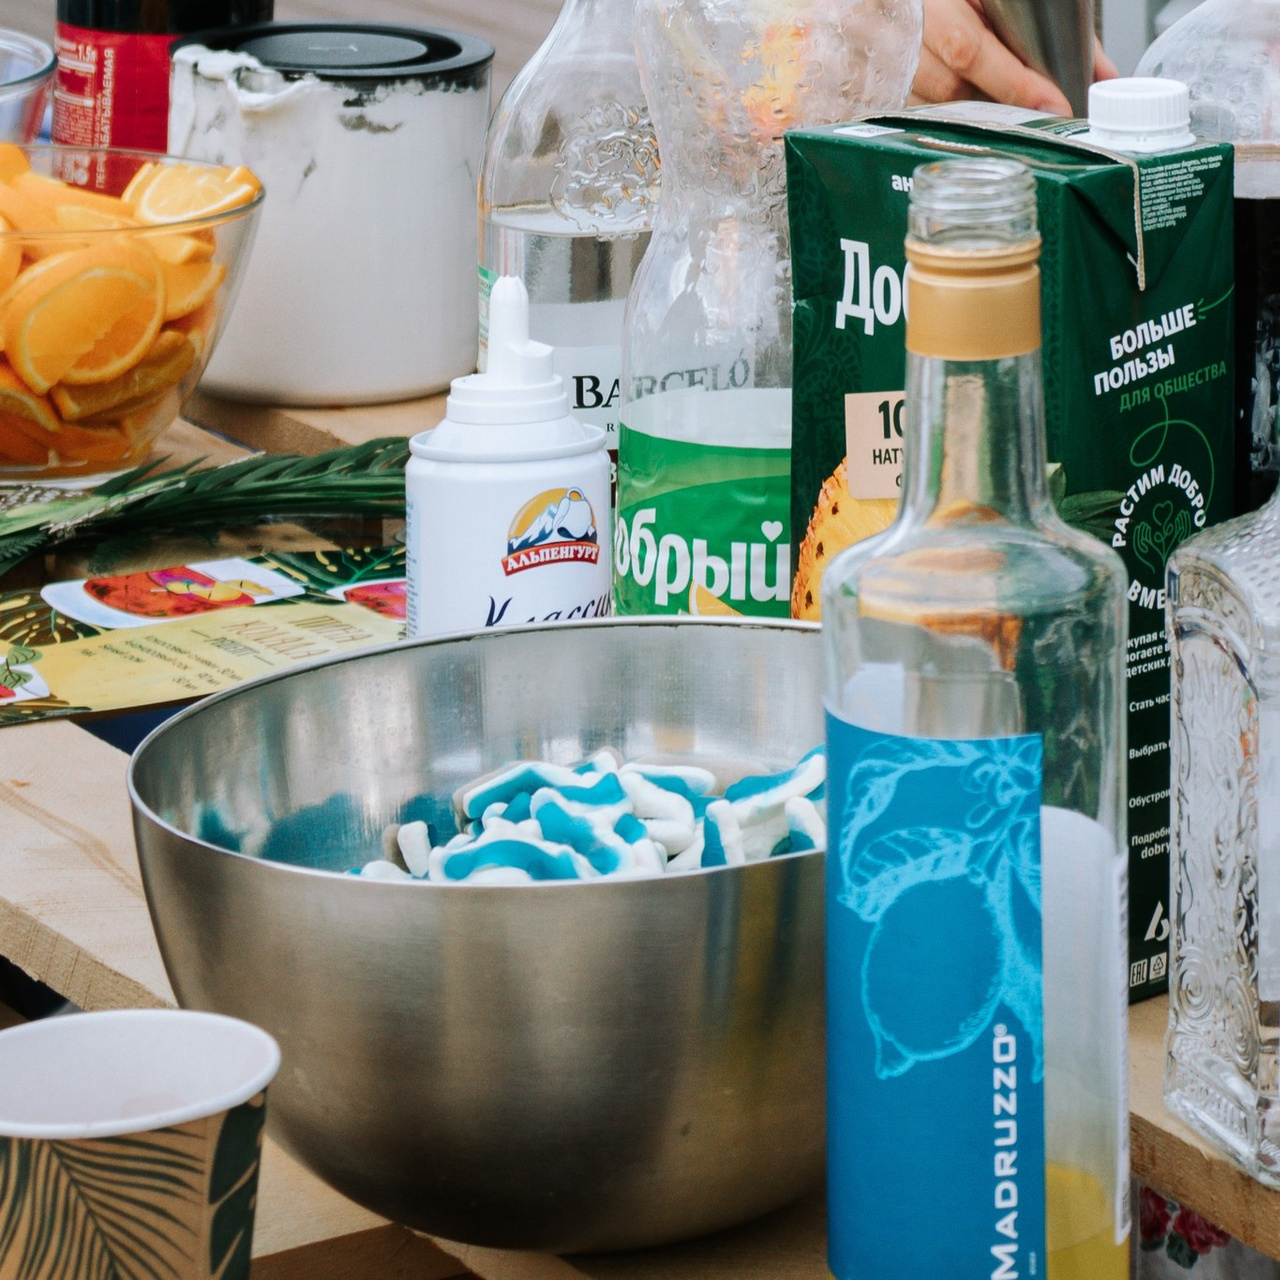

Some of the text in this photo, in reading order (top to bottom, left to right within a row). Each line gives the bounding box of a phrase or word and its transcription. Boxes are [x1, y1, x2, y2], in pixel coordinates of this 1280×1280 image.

[1110, 303, 1197, 361] БОЛЬШЕ
[1094, 344, 1175, 396] ПОЛЬЗЫ
[1120, 360, 1227, 413] ДЛЯ ОБЩЕСТВА
[1112, 463, 1206, 548] РАСТИМ ДОБРО
[507, 546, 598, 572] АЛЬПЕНГУРТ
[615, 507, 791, 606] обрый
[1127, 579, 1166, 610] ВМЕ
[1127, 632, 1158, 648] купая
[1126, 645, 1163, 664] огаете
[1129, 693, 1171, 713] Стать час
[1129, 741, 1168, 760] Выбрать
[1129, 788, 1171, 809] Обустрои
[1131, 826, 1171, 847] Подробн
[1141, 842, 1171, 860] dobry
[990, 1034, 1019, 1280] MADRUZZO
